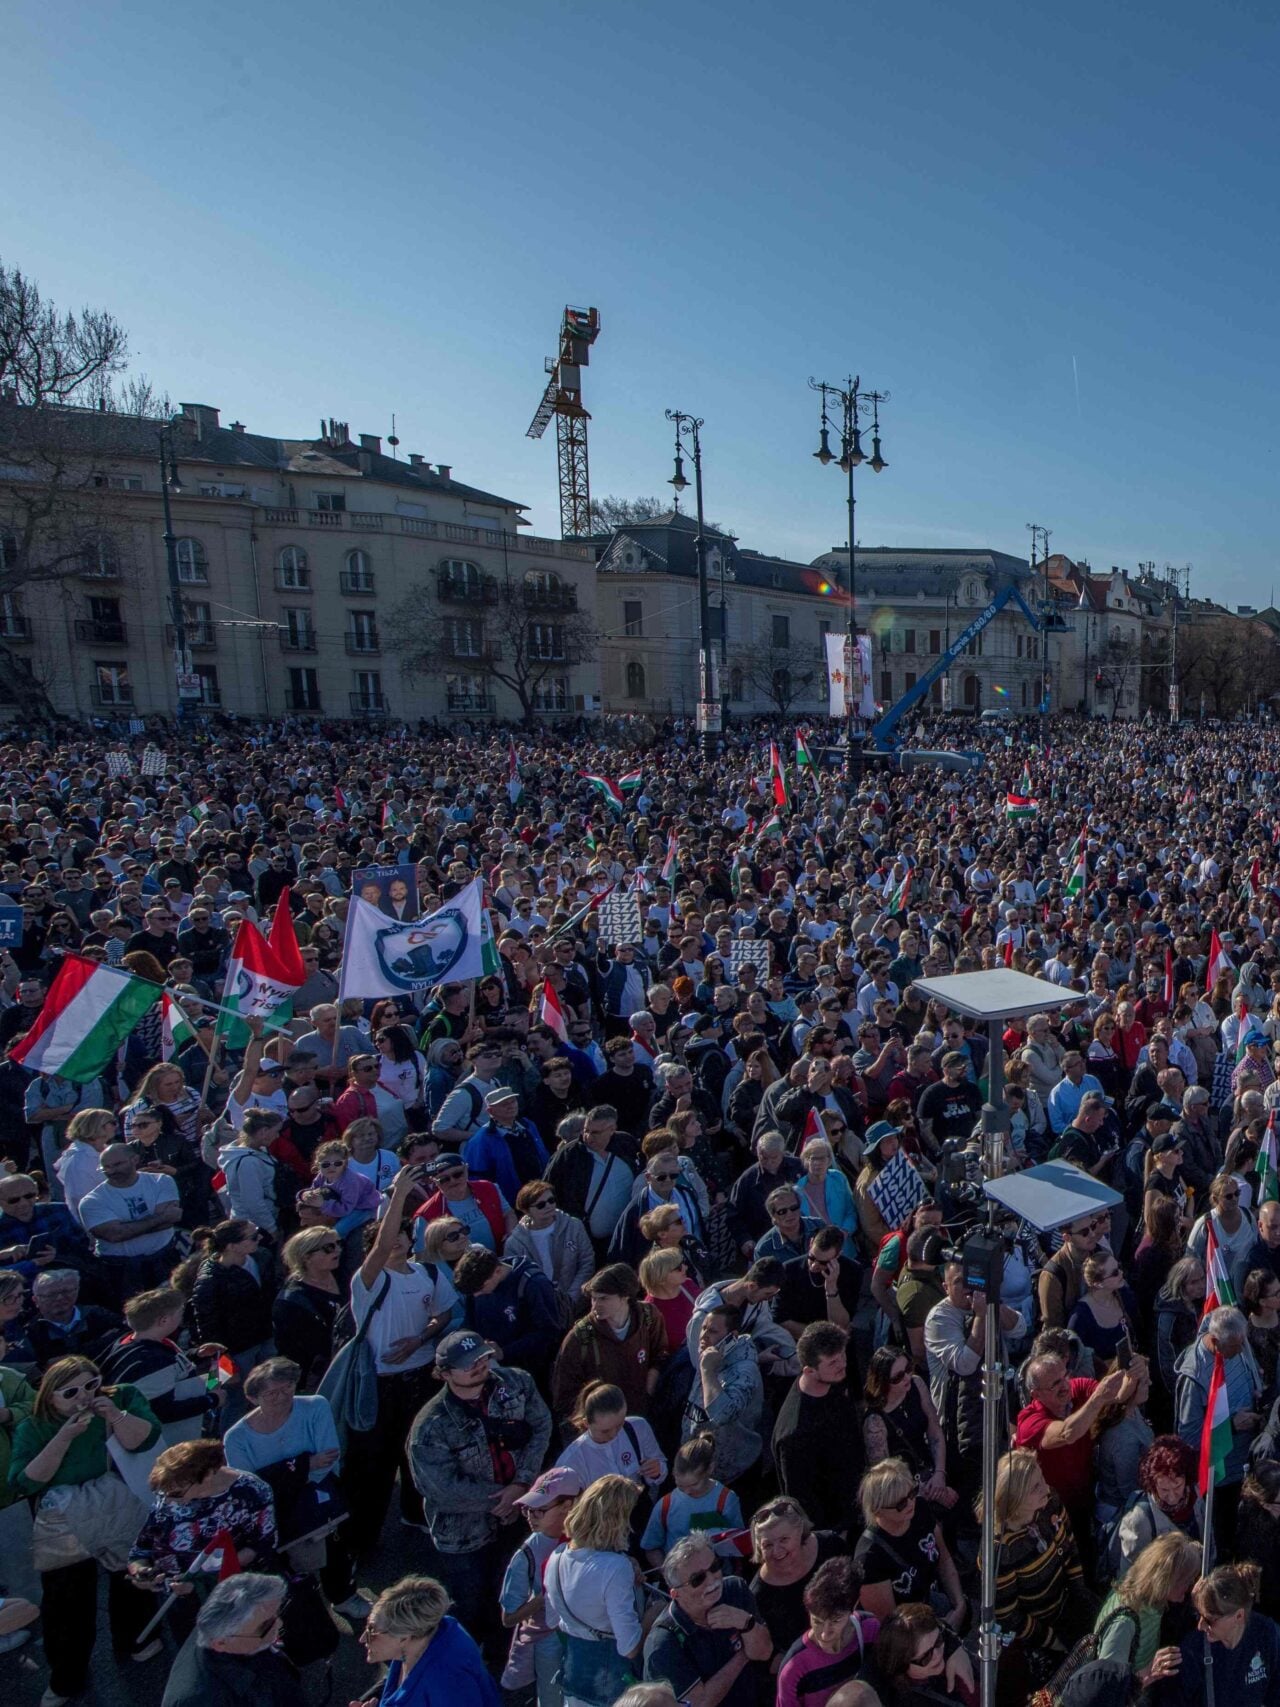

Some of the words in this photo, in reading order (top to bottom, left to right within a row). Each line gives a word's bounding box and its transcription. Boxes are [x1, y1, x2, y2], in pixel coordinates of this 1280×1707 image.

[605, 892, 638, 904] ISZA
[597, 903, 640, 914] TISZA
[598, 913, 641, 925] TISZA
[599, 924, 641, 935] TISZA
[730, 940, 769, 949] TISZA
[730, 950, 769, 960] TISZA
[730, 960, 769, 970] TZA
[866, 1147, 906, 1198] TISZA
[874, 1158, 915, 1211] TISZA
[882, 1170, 923, 1225] TISZA
[460, 1337, 477, 1351] NY
